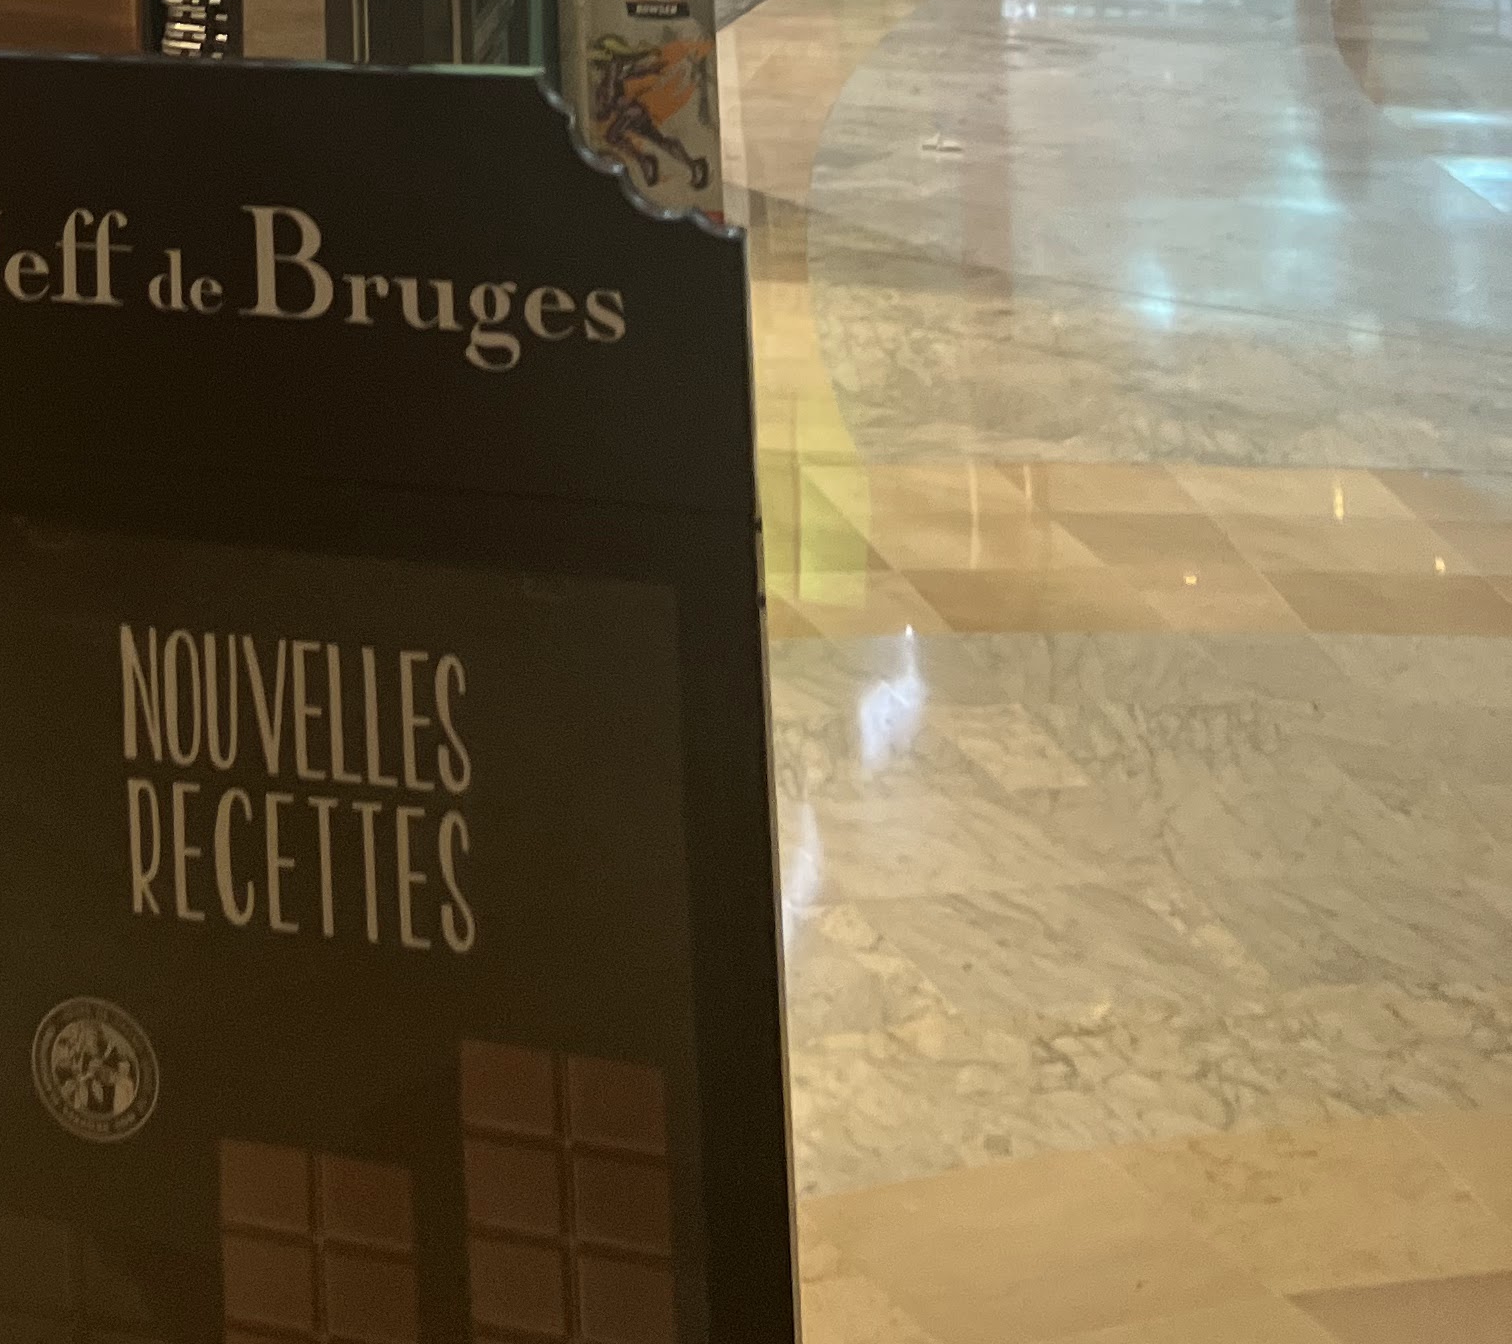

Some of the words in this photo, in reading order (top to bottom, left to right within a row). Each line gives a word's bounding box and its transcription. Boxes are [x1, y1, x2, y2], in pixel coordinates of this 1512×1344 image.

[148, 246, 225, 316] de
[240, 204, 627, 372] Bruges
[119, 623, 472, 794] NOUVELLES
[126, 779, 476, 955] RECETTES
